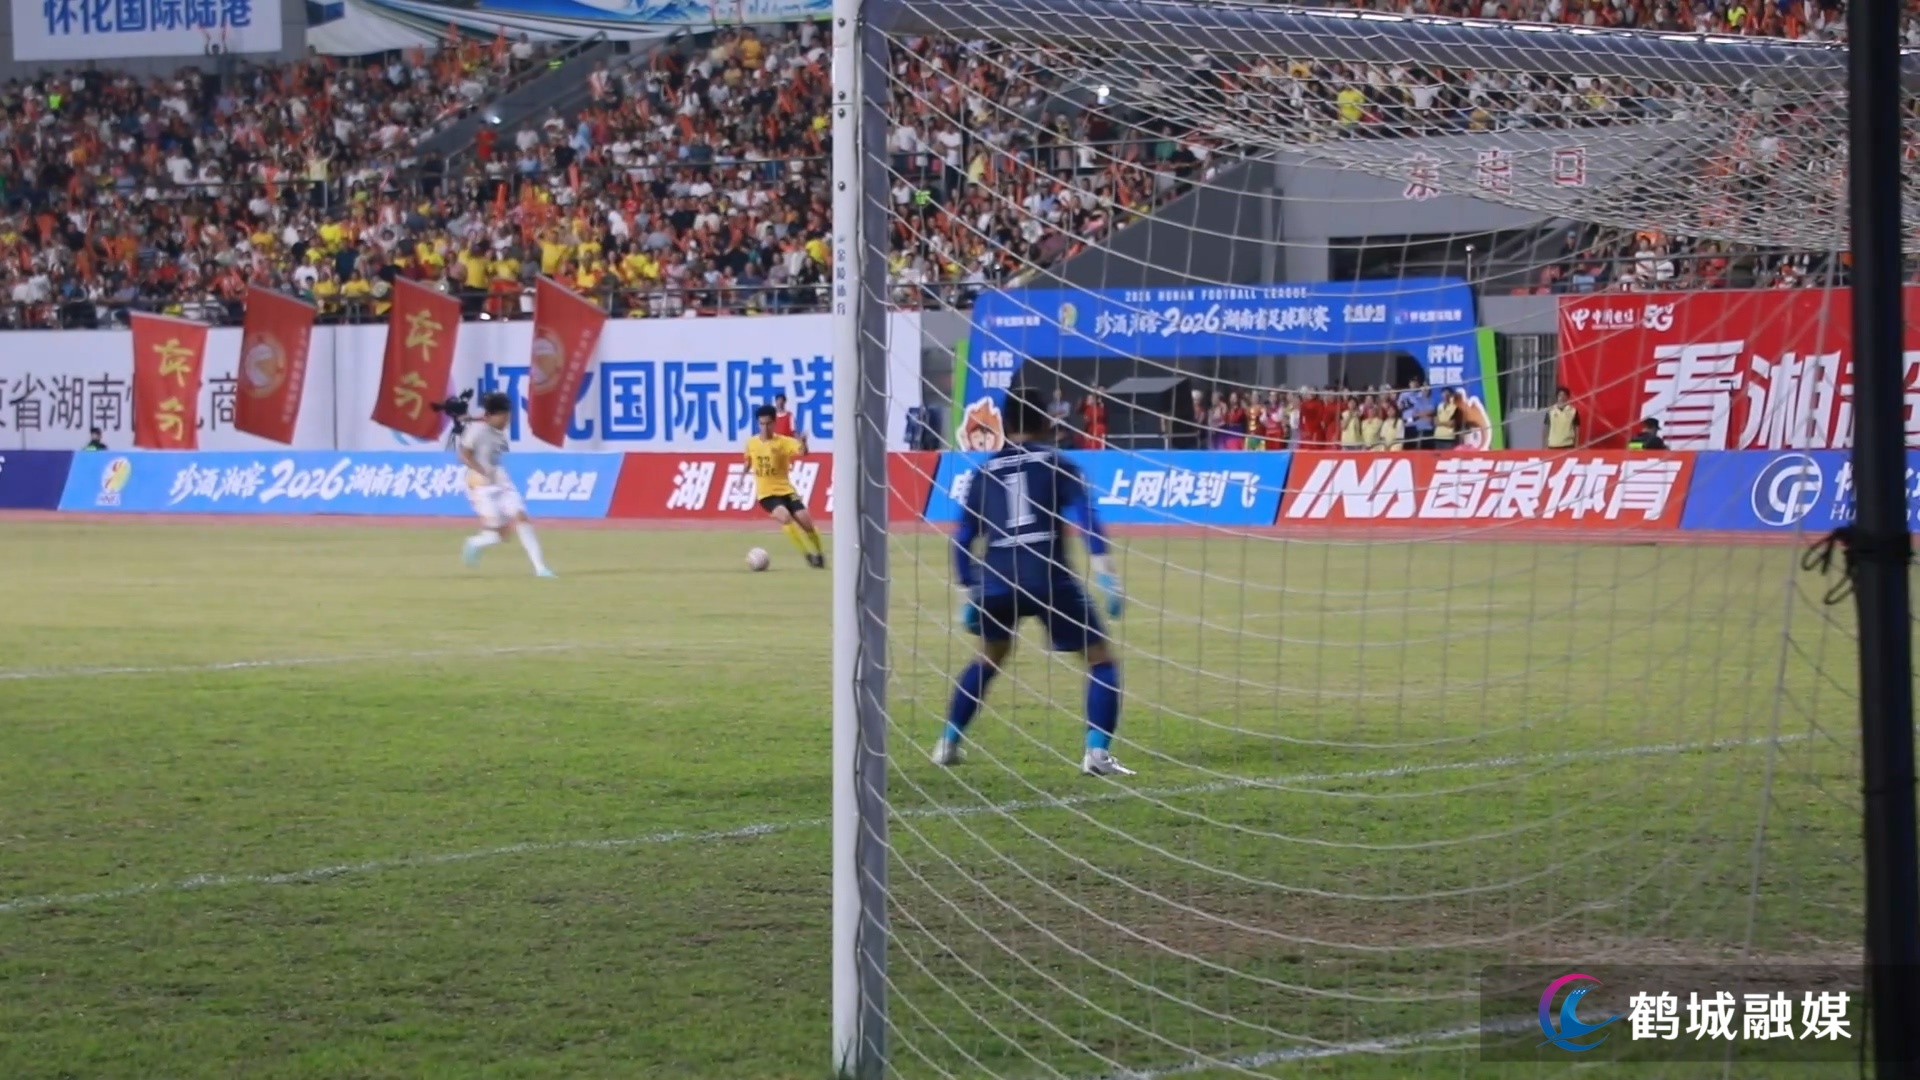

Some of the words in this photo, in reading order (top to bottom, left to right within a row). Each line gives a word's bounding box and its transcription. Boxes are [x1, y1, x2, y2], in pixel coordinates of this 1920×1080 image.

[43, 0, 252, 35] 怀化国际陆港
[1158, 289, 1195, 301] HUNAN
[1201, 288, 1257, 301] FOOTBALL
[1264, 286, 1307, 299] LEAGUE
[1643, 302, 1675, 332] 5G
[0, 372, 237, 432] 省湖南商
[1002, 470, 1038, 529] 1
[1098, 468, 1261, 508] 上网快到飞
[1418, 456, 1683, 521] 茵浪体育
